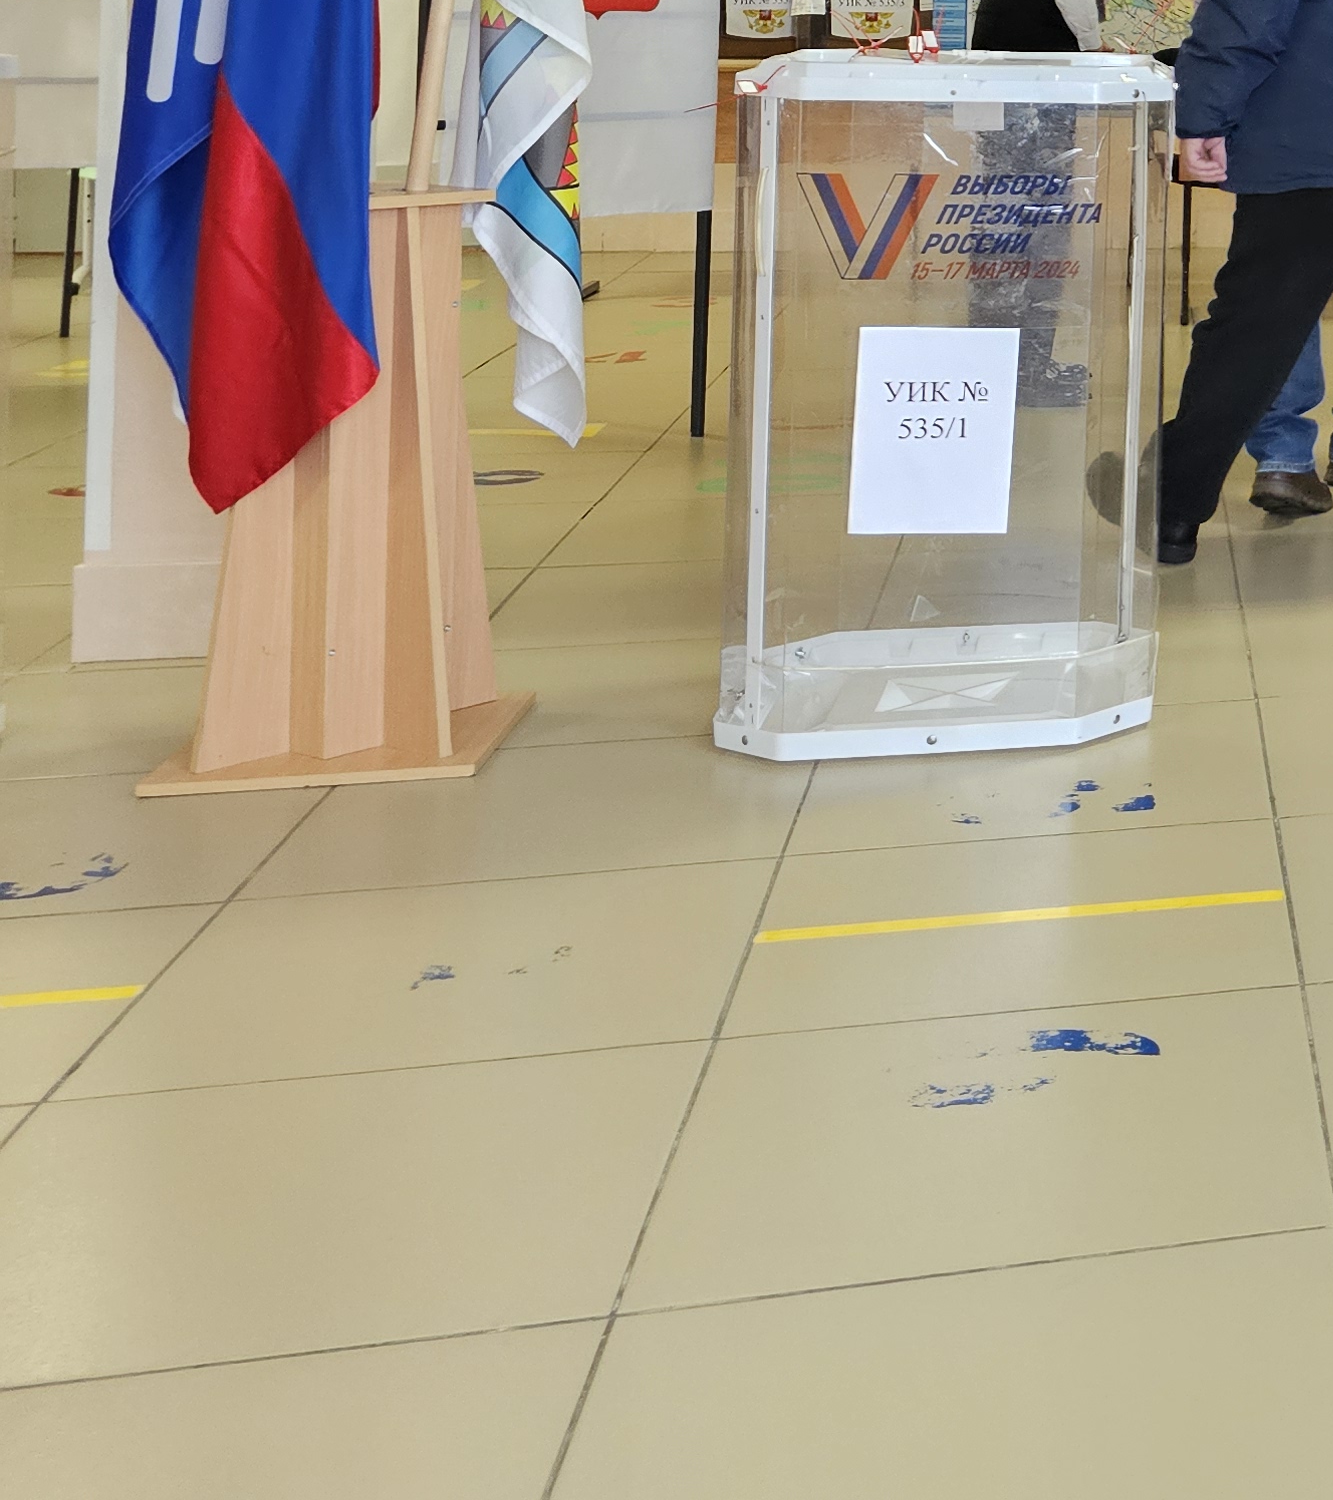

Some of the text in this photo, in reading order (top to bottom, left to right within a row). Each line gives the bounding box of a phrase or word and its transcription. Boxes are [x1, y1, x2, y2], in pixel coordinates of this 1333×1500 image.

[950, 174, 1073, 196] ВЫБОРЫ
[935, 202, 1103, 228] ПРЕЗИДЕНТА
[920, 233, 1033, 255] РОССИИ
[964, 261, 1030, 280] МАРТА
[1032, 260, 1081, 280] 2024
[883, 380, 989, 403] УИК №
[897, 417, 968, 440] 535/1
